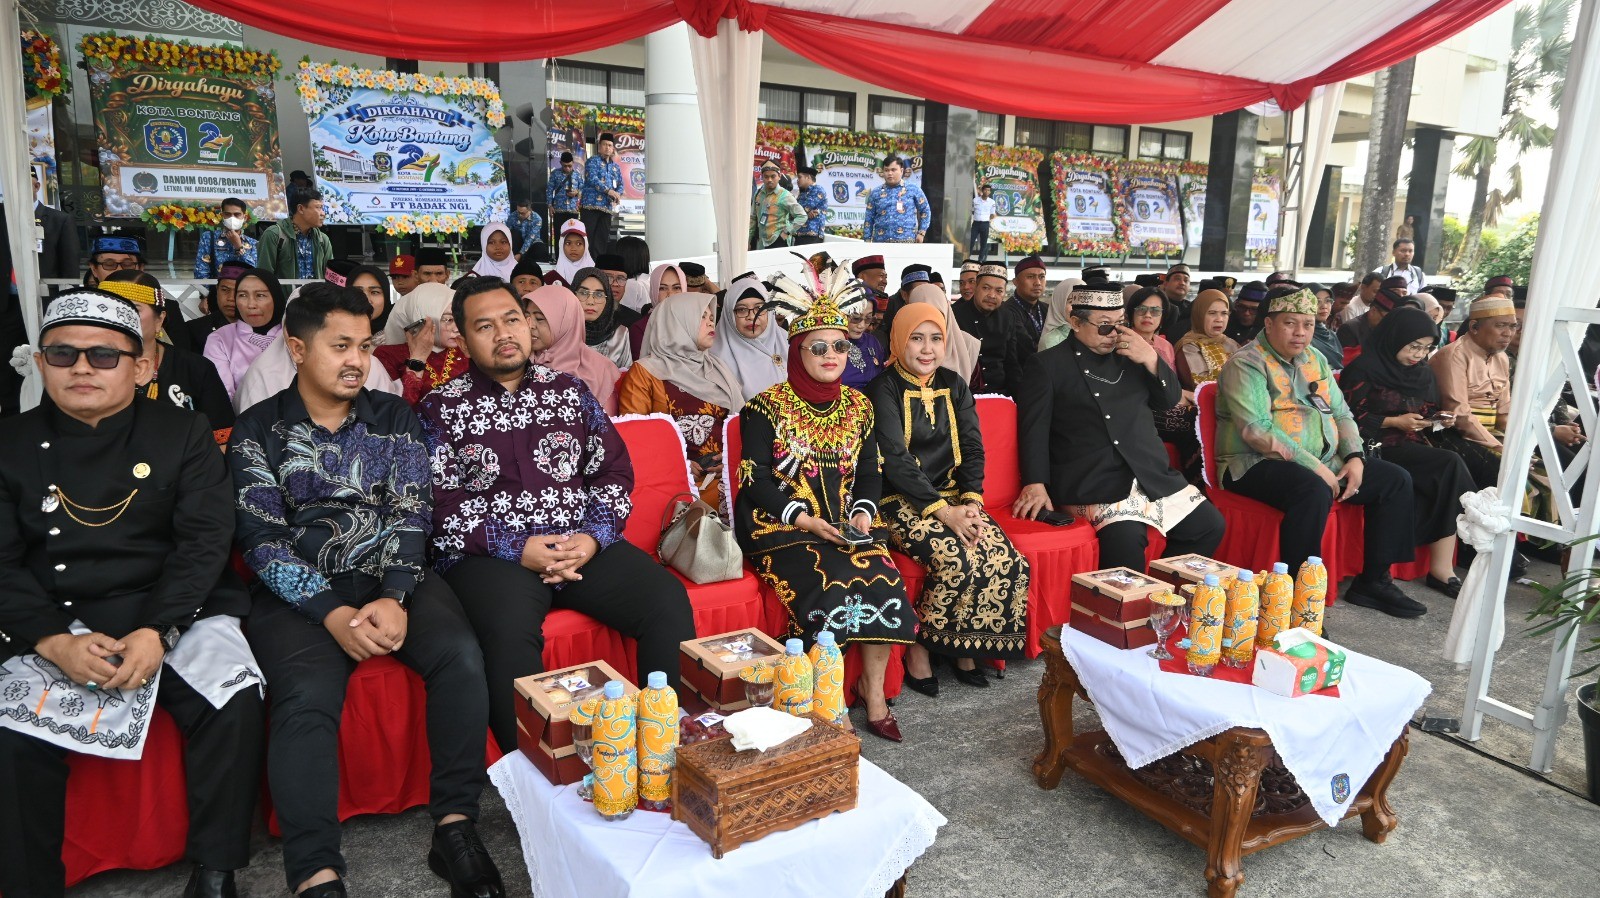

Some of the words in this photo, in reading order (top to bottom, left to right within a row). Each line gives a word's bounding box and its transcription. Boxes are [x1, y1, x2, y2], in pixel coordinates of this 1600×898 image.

[127, 74, 245, 101] Dirgahayu
[136, 105, 174, 116] KOTA
[177, 108, 240, 121] BONTANG
[366, 106, 447, 121] DIRGAHAYU
[346, 125, 398, 145] Kota
[398, 126, 472, 151] Bontang
[615, 135, 645, 150] Dirg
[754, 146, 781, 160] ahayu
[823, 152, 876, 167] Dirgahayu
[163, 175, 196, 184] DANDIM
[986, 166, 1028, 180] Dirgahayu
[409, 202, 446, 210] BADAK
[450, 202, 472, 210] NGL
